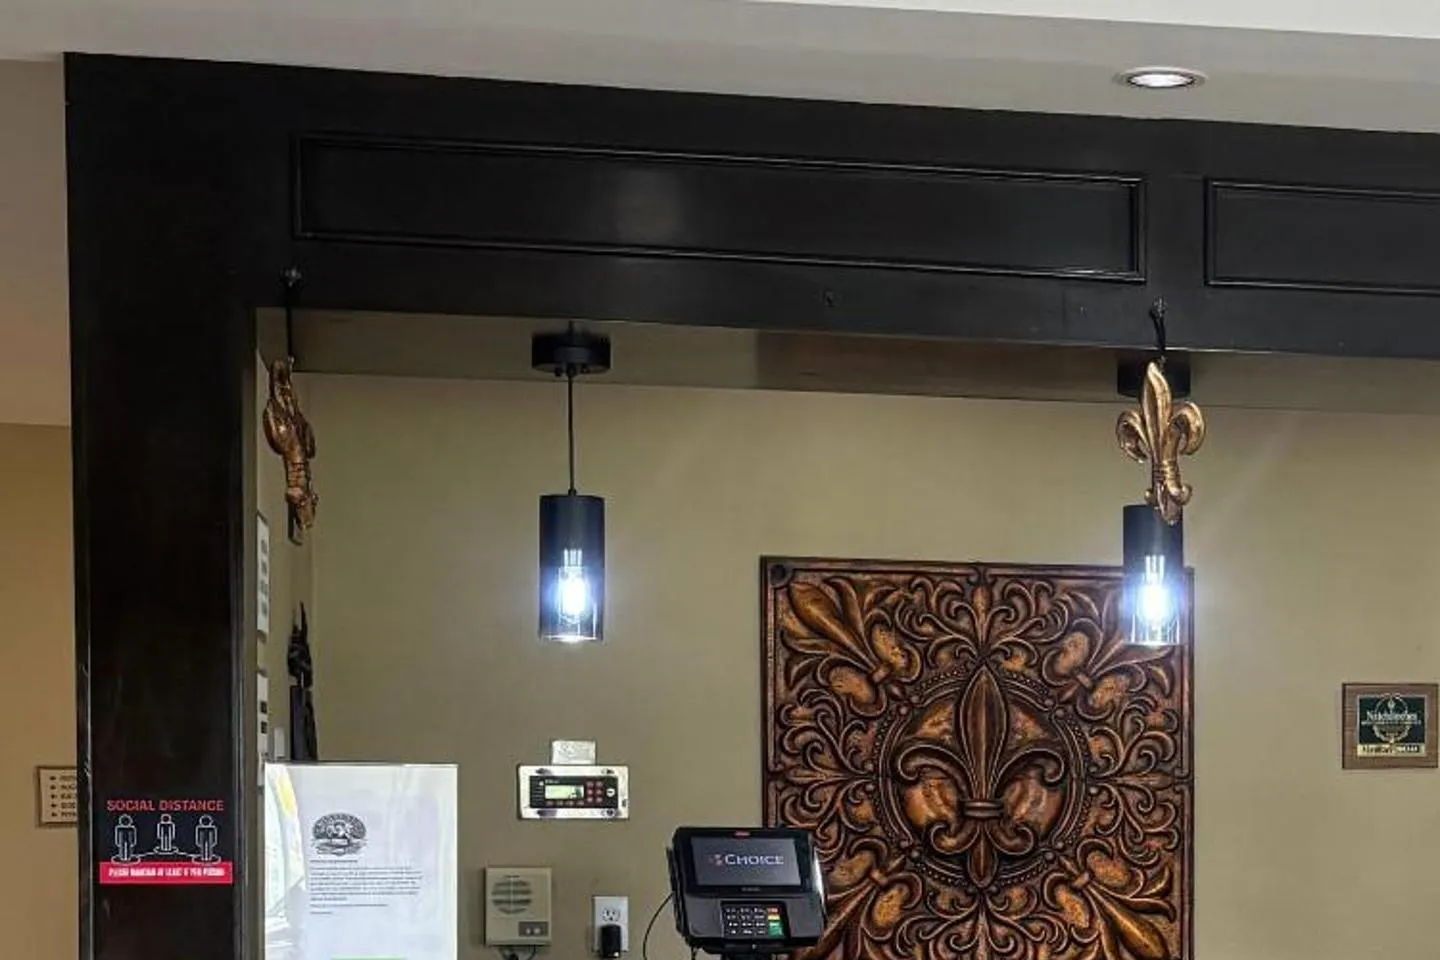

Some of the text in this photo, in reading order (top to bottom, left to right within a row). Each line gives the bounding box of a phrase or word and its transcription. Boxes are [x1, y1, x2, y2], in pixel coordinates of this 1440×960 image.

[106, 799, 225, 812] SOCIAL DISTANCE
[724, 854, 785, 866] CHOICE
